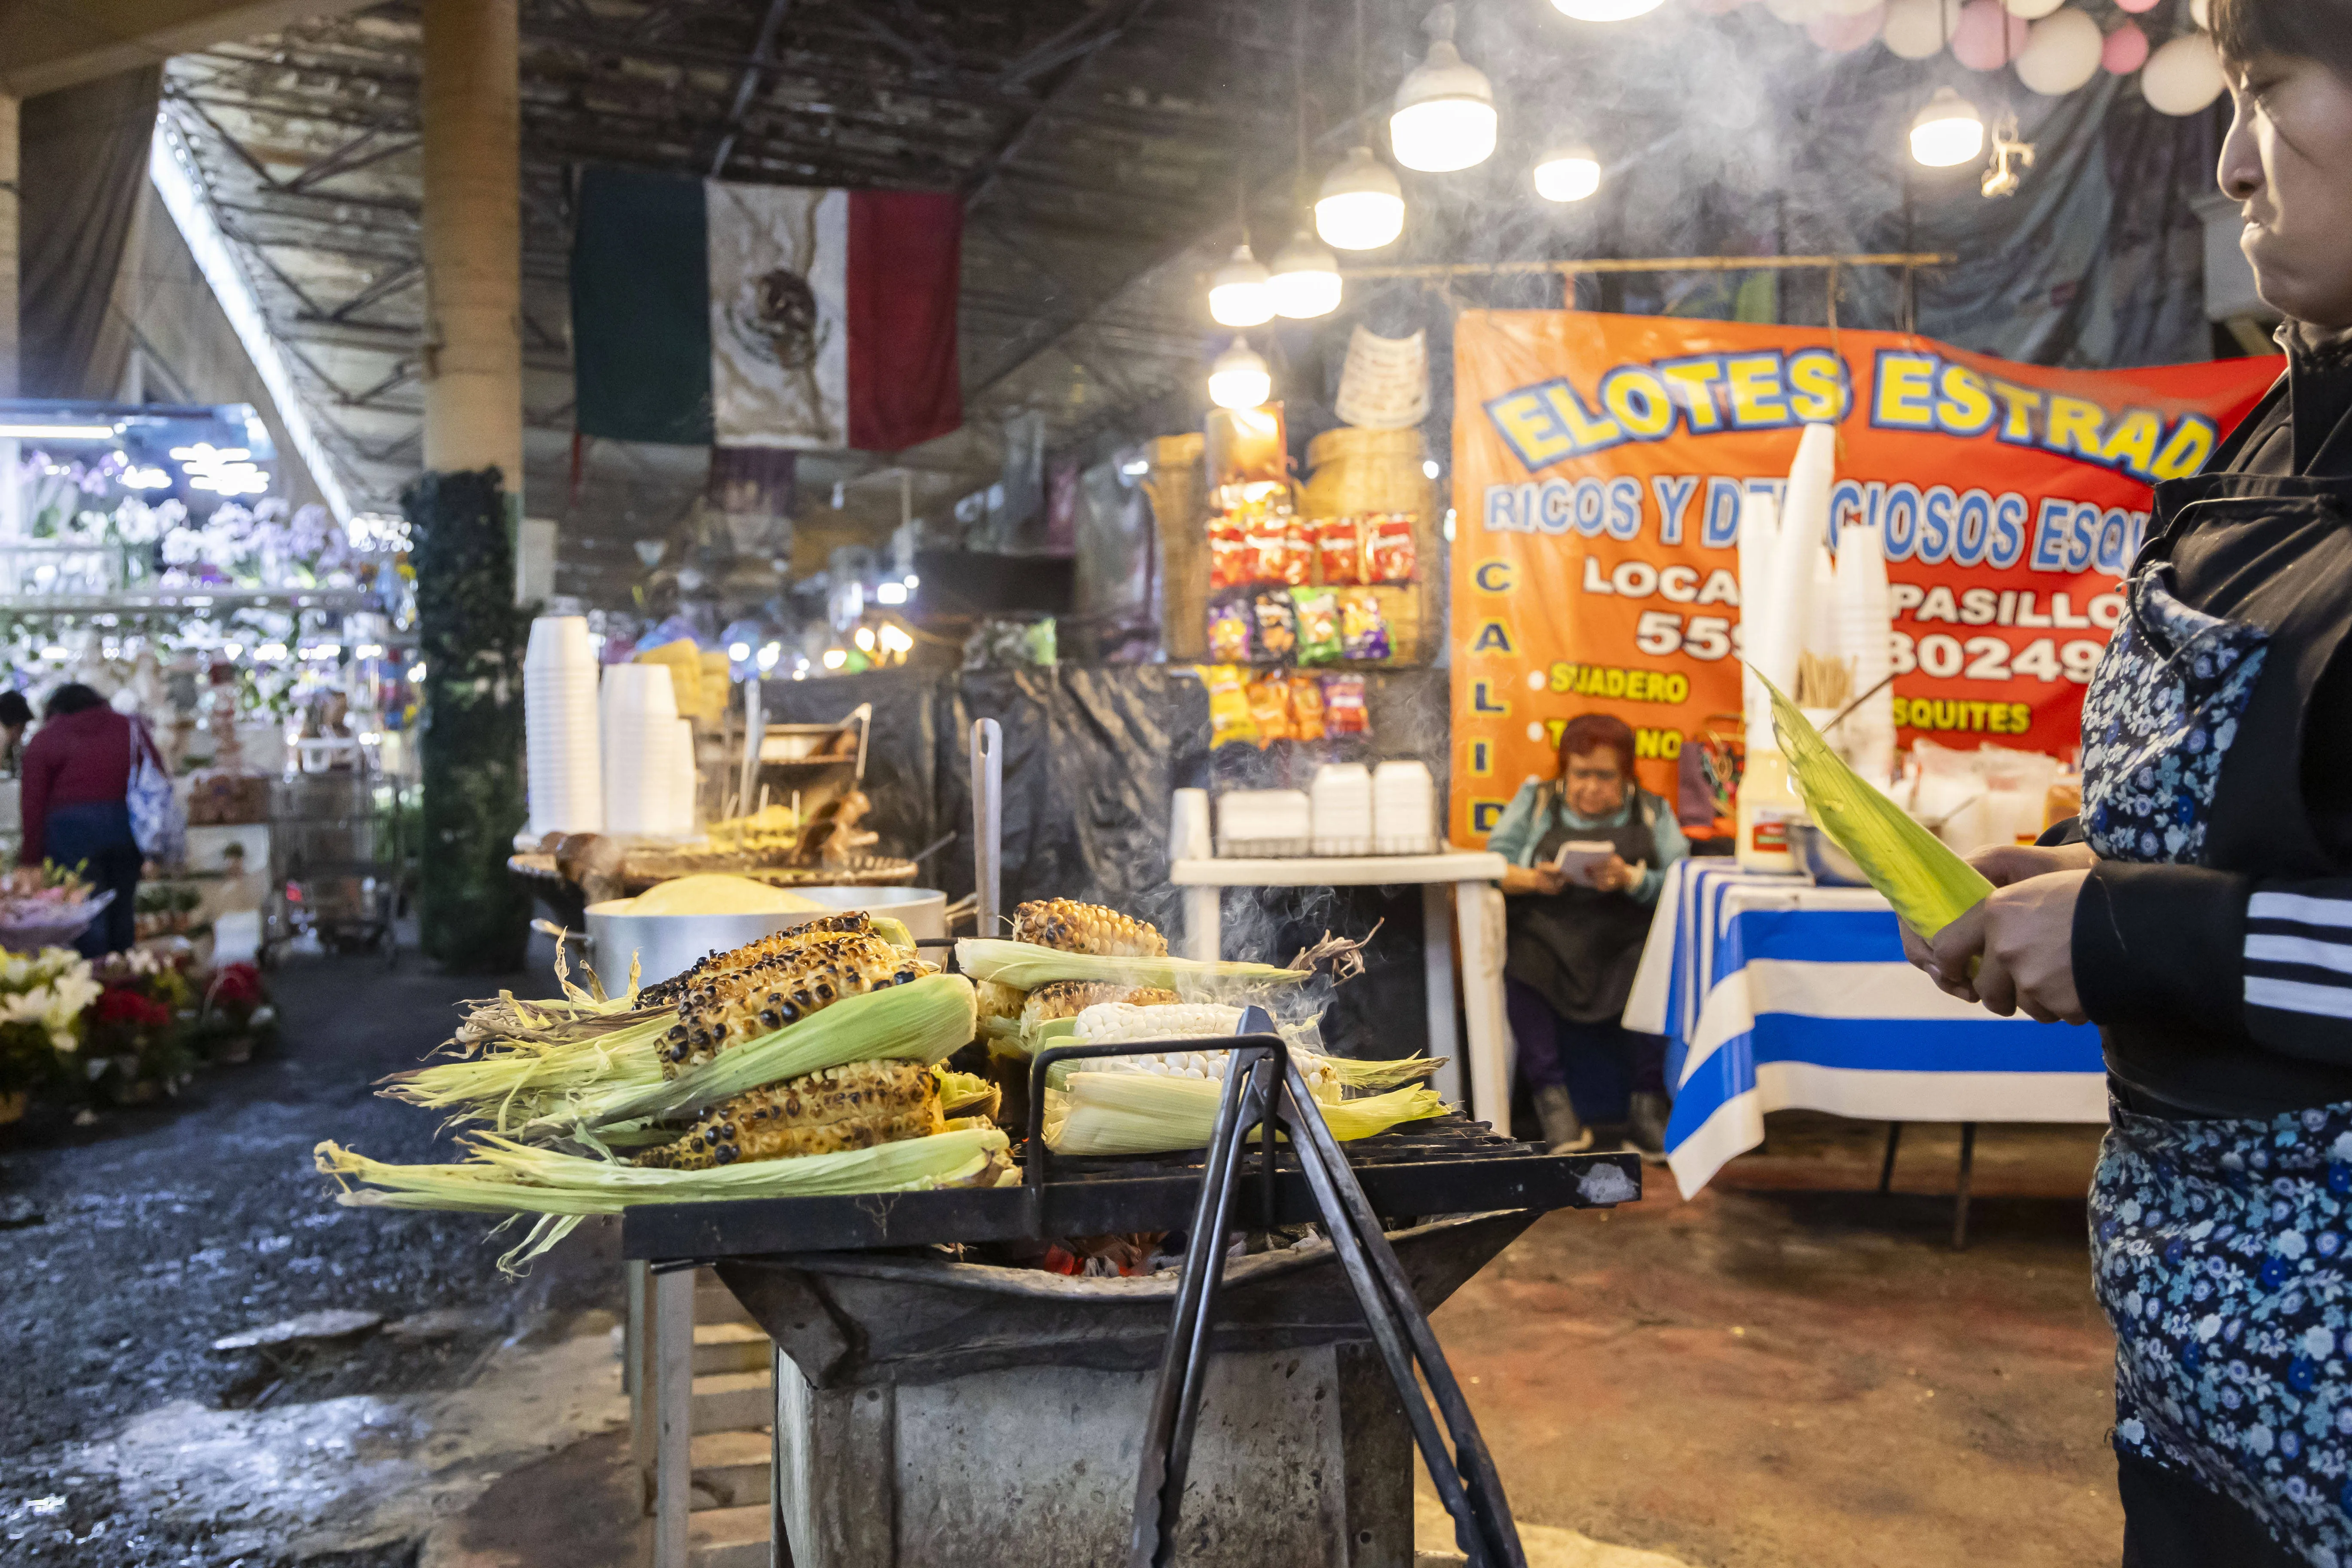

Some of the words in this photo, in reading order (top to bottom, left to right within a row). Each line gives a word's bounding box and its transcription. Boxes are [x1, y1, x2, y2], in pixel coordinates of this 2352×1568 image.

[1483, 347, 1854, 472] ELOTES
[1484, 477, 1642, 540] RICOS
[1651, 475, 1701, 545] Y
[1702, 475, 2028, 570] DCIOSOS
[1890, 583, 2127, 629] PASILLO
